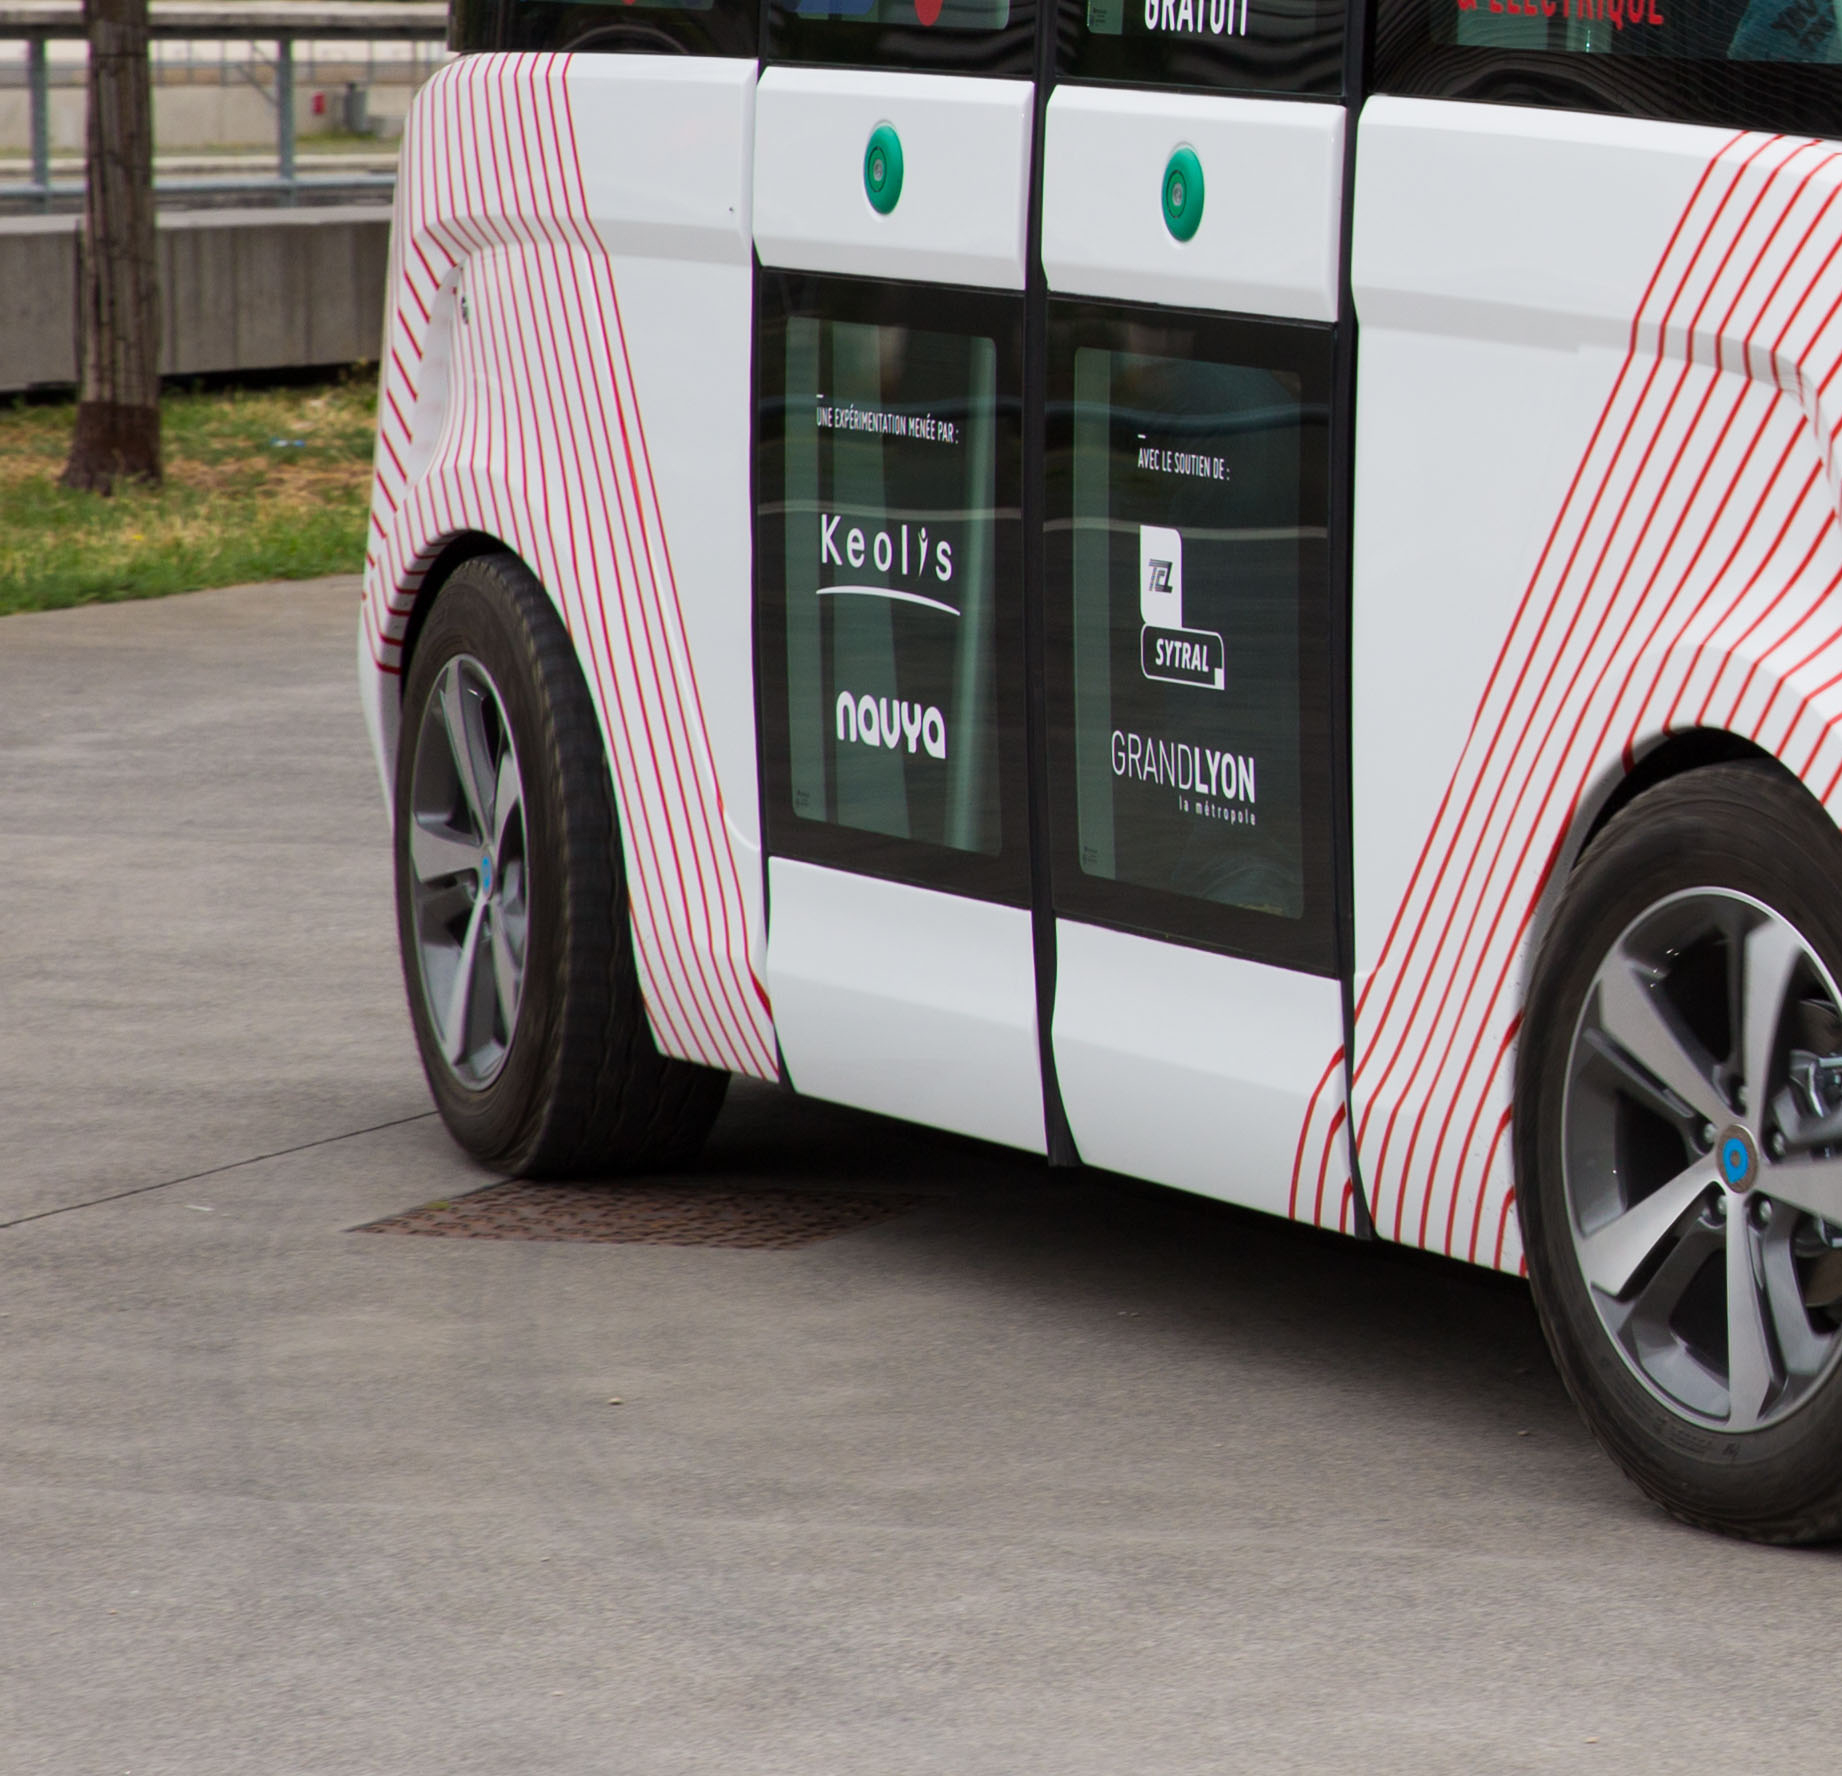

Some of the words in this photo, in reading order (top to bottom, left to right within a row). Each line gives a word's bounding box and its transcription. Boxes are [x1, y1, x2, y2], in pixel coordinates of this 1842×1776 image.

[816, 406, 833, 429] UNE
[834, 404, 907, 436] EXPÉRIMENTATION
[908, 412, 937, 441] MENÉE
[1138, 447, 1159, 470] AVEC
[1162, 450, 1172, 472] LE
[1174, 452, 1211, 477] SOUTIEN
[821, 513, 952, 582] Keolis
[1155, 638, 1210, 673] SYTRAL
[1111, 730, 1256, 804] GRANDLYON
[1178, 794, 1190, 813] la
[1195, 800, 1256, 826] métropole
